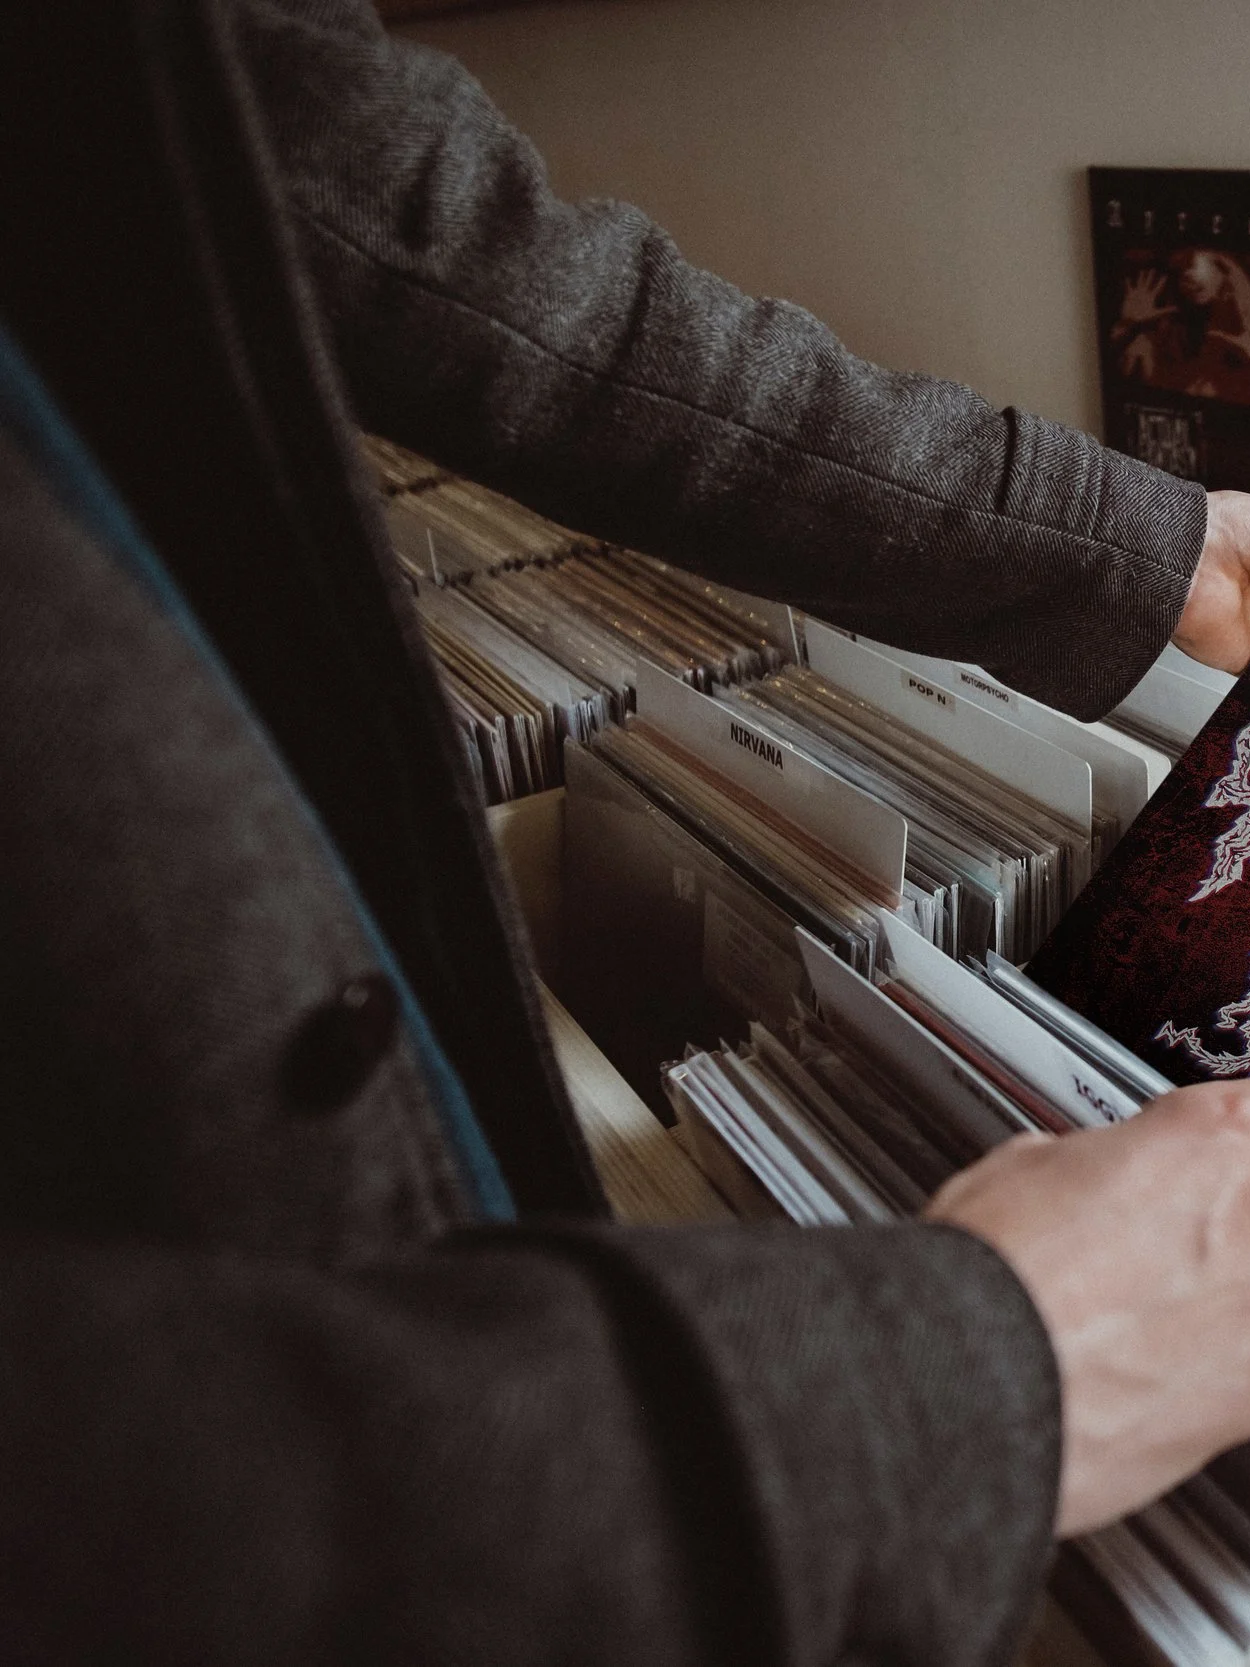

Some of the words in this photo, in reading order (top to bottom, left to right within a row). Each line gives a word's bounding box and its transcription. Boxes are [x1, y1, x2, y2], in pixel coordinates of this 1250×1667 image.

[908, 678, 934, 697] POP
[937, 693, 947, 706] N
[960, 672, 1010, 703] MOTORPSYCHO
[730, 722, 784, 770] NIRVANA
[1072, 1073, 1128, 1123] IGG
